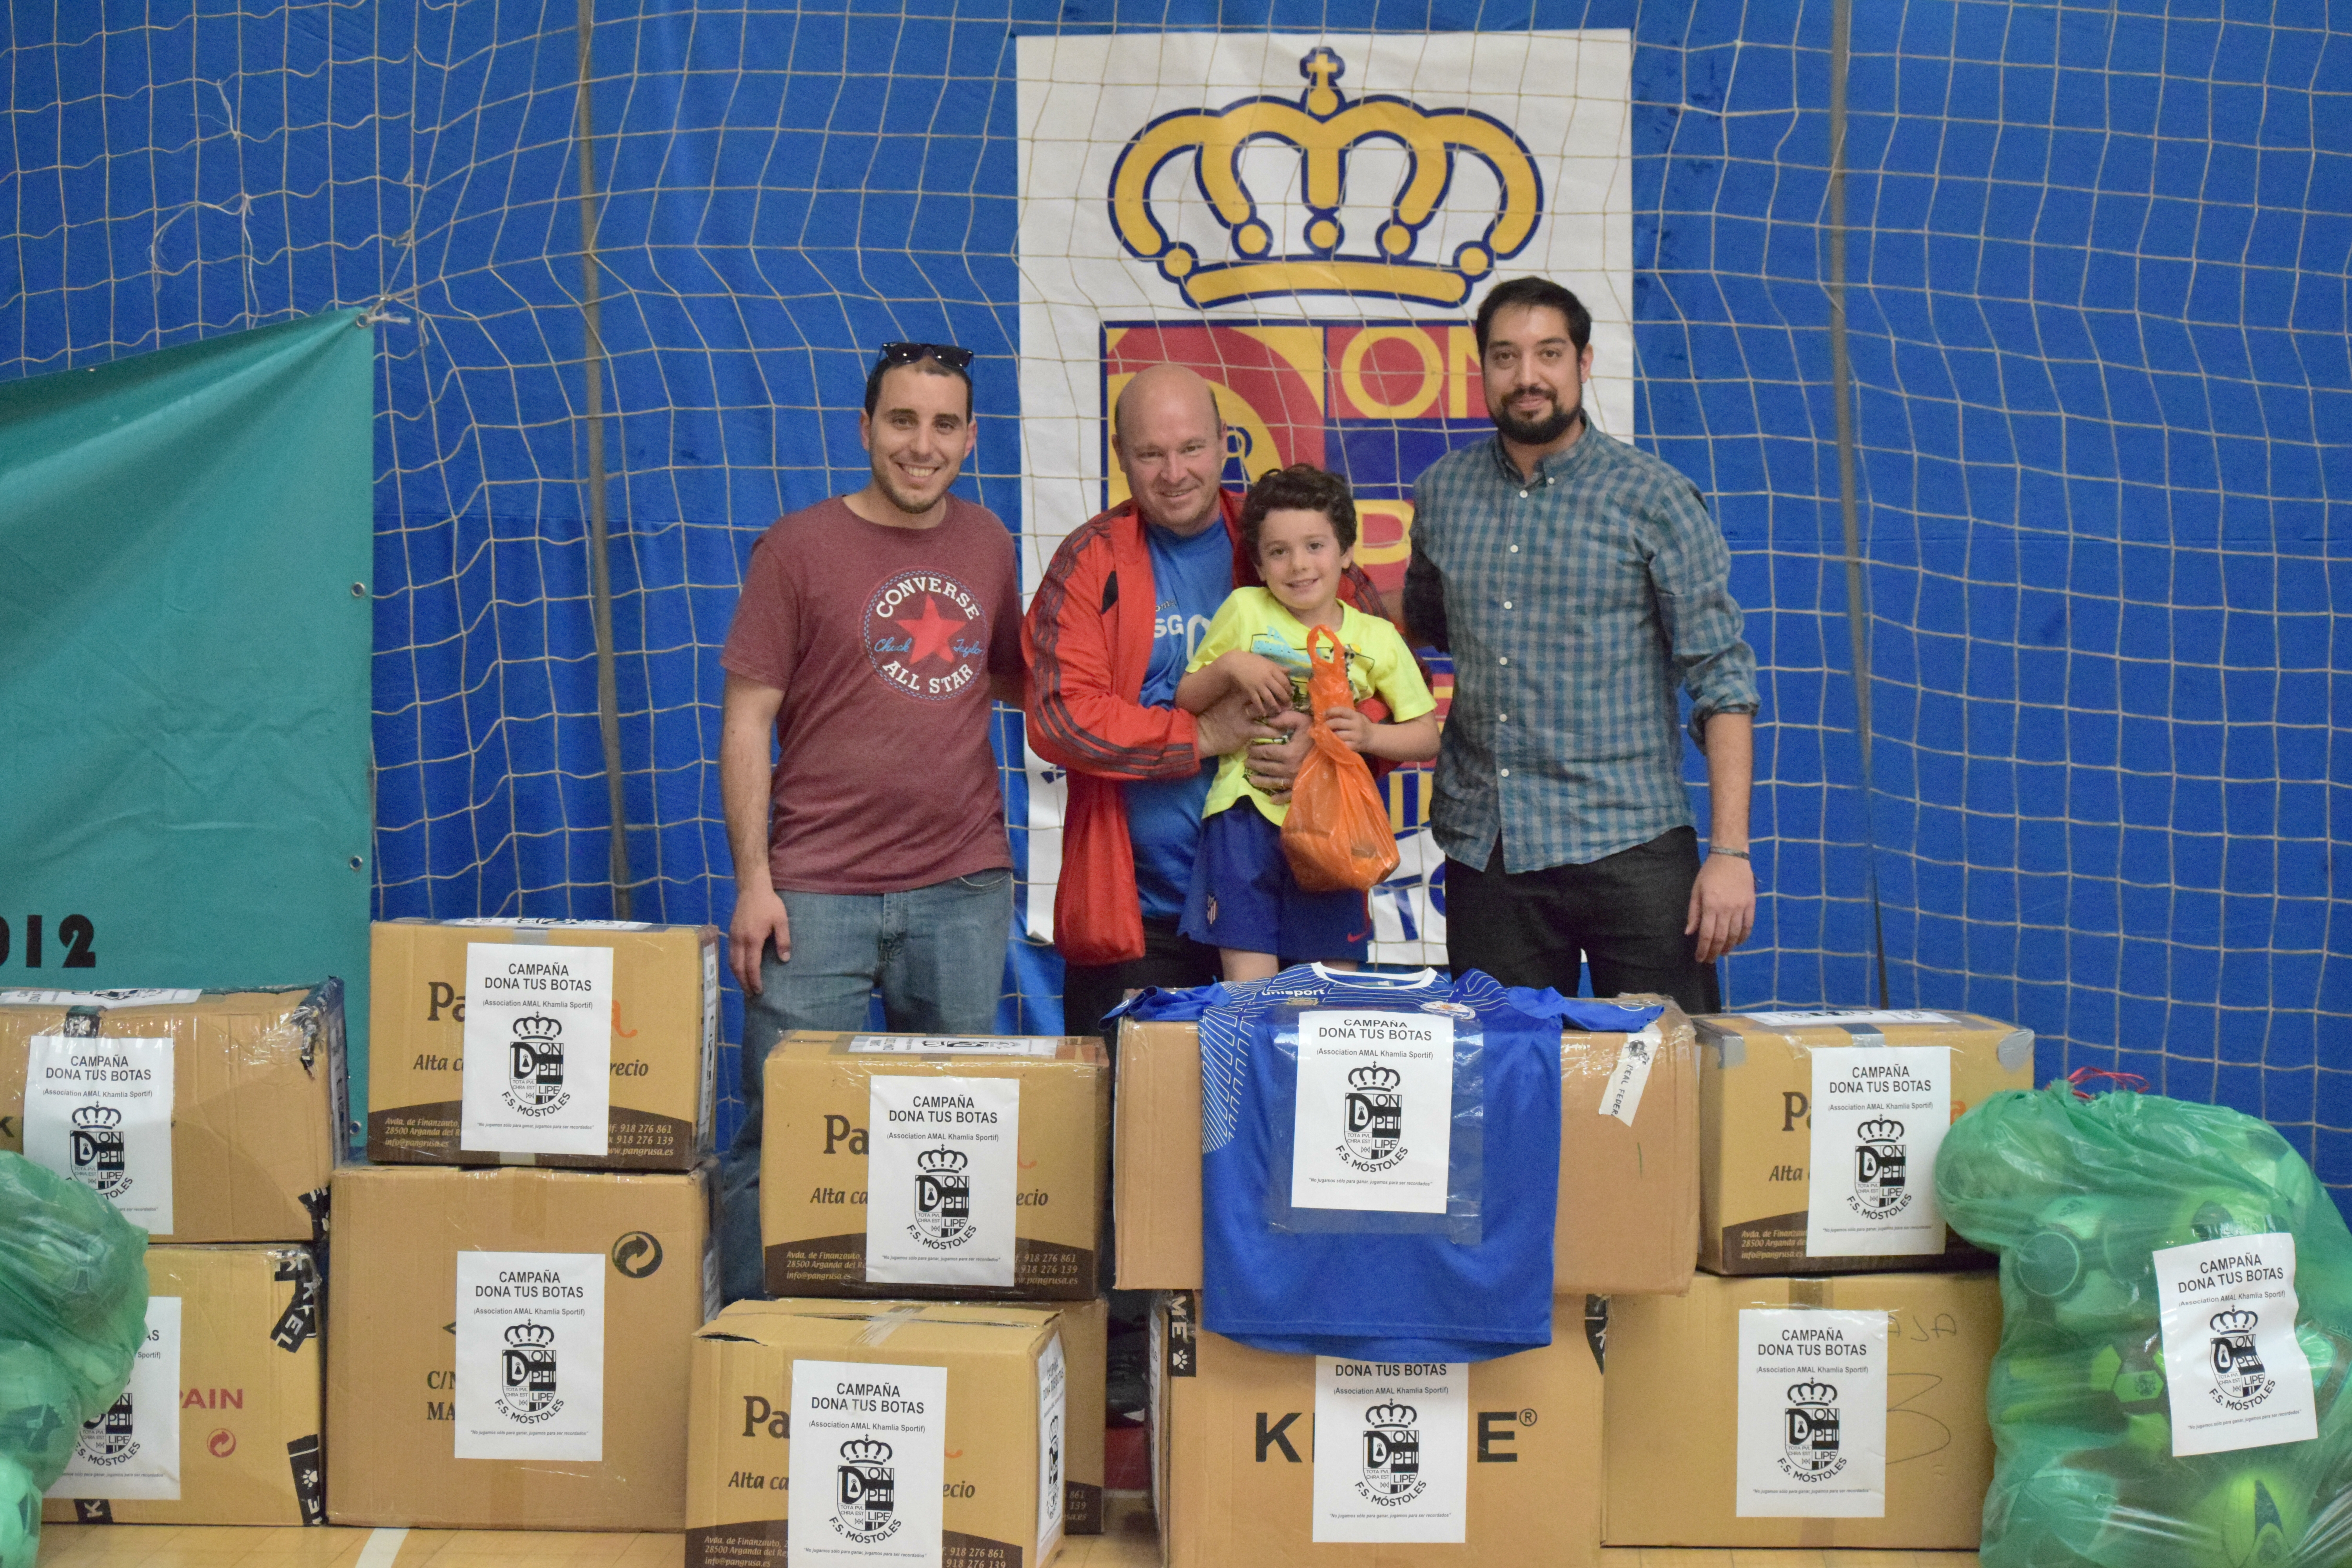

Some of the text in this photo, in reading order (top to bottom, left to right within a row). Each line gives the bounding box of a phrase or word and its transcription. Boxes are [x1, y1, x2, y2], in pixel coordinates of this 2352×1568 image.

[876, 577, 980, 620] CONVERSE
[874, 637, 912, 652] Chuck
[882, 661, 973, 693] ALL STAR
[0, 914, 96, 967] 12
[509, 962, 569, 976] CAMPAÑA
[485, 977, 592, 991] DONA TUS BOTAS
[1262, 988, 1325, 997] unisport
[1344, 1018, 1408, 1027] CAMPAÑA
[1319, 1027, 1432, 1041] DONA TUS BOTAS
[71, 1054, 129, 1067] CAMPAÑA
[413, 1054, 448, 1071] Alta
[610, 1059, 649, 1076] recio
[46, 1068, 151, 1081] DONA TUS BOTAS
[1853, 1063, 1911, 1079] CAMPAÑA
[1830, 1080, 1931, 1093] DONA TUS BOTAS
[517, 1091, 571, 1118] MÓSTOLES
[913, 1094, 975, 1108] CAMPAÑA
[889, 1110, 998, 1123] DONA TUS BOTAS
[409, 1127, 440, 1136] Arganda
[621, 1124, 636, 1132] 918
[638, 1125, 654, 1133] 276
[656, 1125, 671, 1133] 861
[617, 1135, 673, 1145] 918 276 139
[608, 1148, 674, 1156] ww.pangrusa.es
[1351, 1145, 1408, 1174] MÓSTOLES
[1768, 1165, 1803, 1181] Alta
[100, 1177, 133, 1200] TOLES
[810, 1187, 846, 1204] Alta
[1016, 1189, 1049, 1206] ecio
[1862, 1192, 1913, 1221] MÓSTOLES
[922, 1224, 977, 1250] MÓSTOLES
[2200, 1253, 2262, 1274] CAMPAÑA
[499, 1270, 561, 1283] CAMPAÑA
[2178, 1267, 2283, 1293] DONA TUS BOTAS
[475, 1286, 583, 1298] DONA TUS BOTAS
[1782, 1327, 1844, 1341] CAMPAÑA
[1758, 1344, 1867, 1356] DONA TUS BOTAS
[1336, 1364, 1447, 1377] DONA TUS BOTAS
[837, 1381, 901, 1397] CAMPAÑA
[2226, 1379, 2276, 1411] MÓSTOLES
[510, 1398, 564, 1424] MÓSTOLES
[811, 1397, 924, 1414] DONA TUS BOTAS
[1793, 1457, 1847, 1483] MÓSTOLES
[728, 1471, 765, 1489] Alta
[943, 1481, 975, 1498] ecio
[1371, 1480, 1427, 1507] MÓSTOLES
[845, 1516, 902, 1545] MÓSTOLES
[950, 1547, 1004, 1558] 918 276 861
